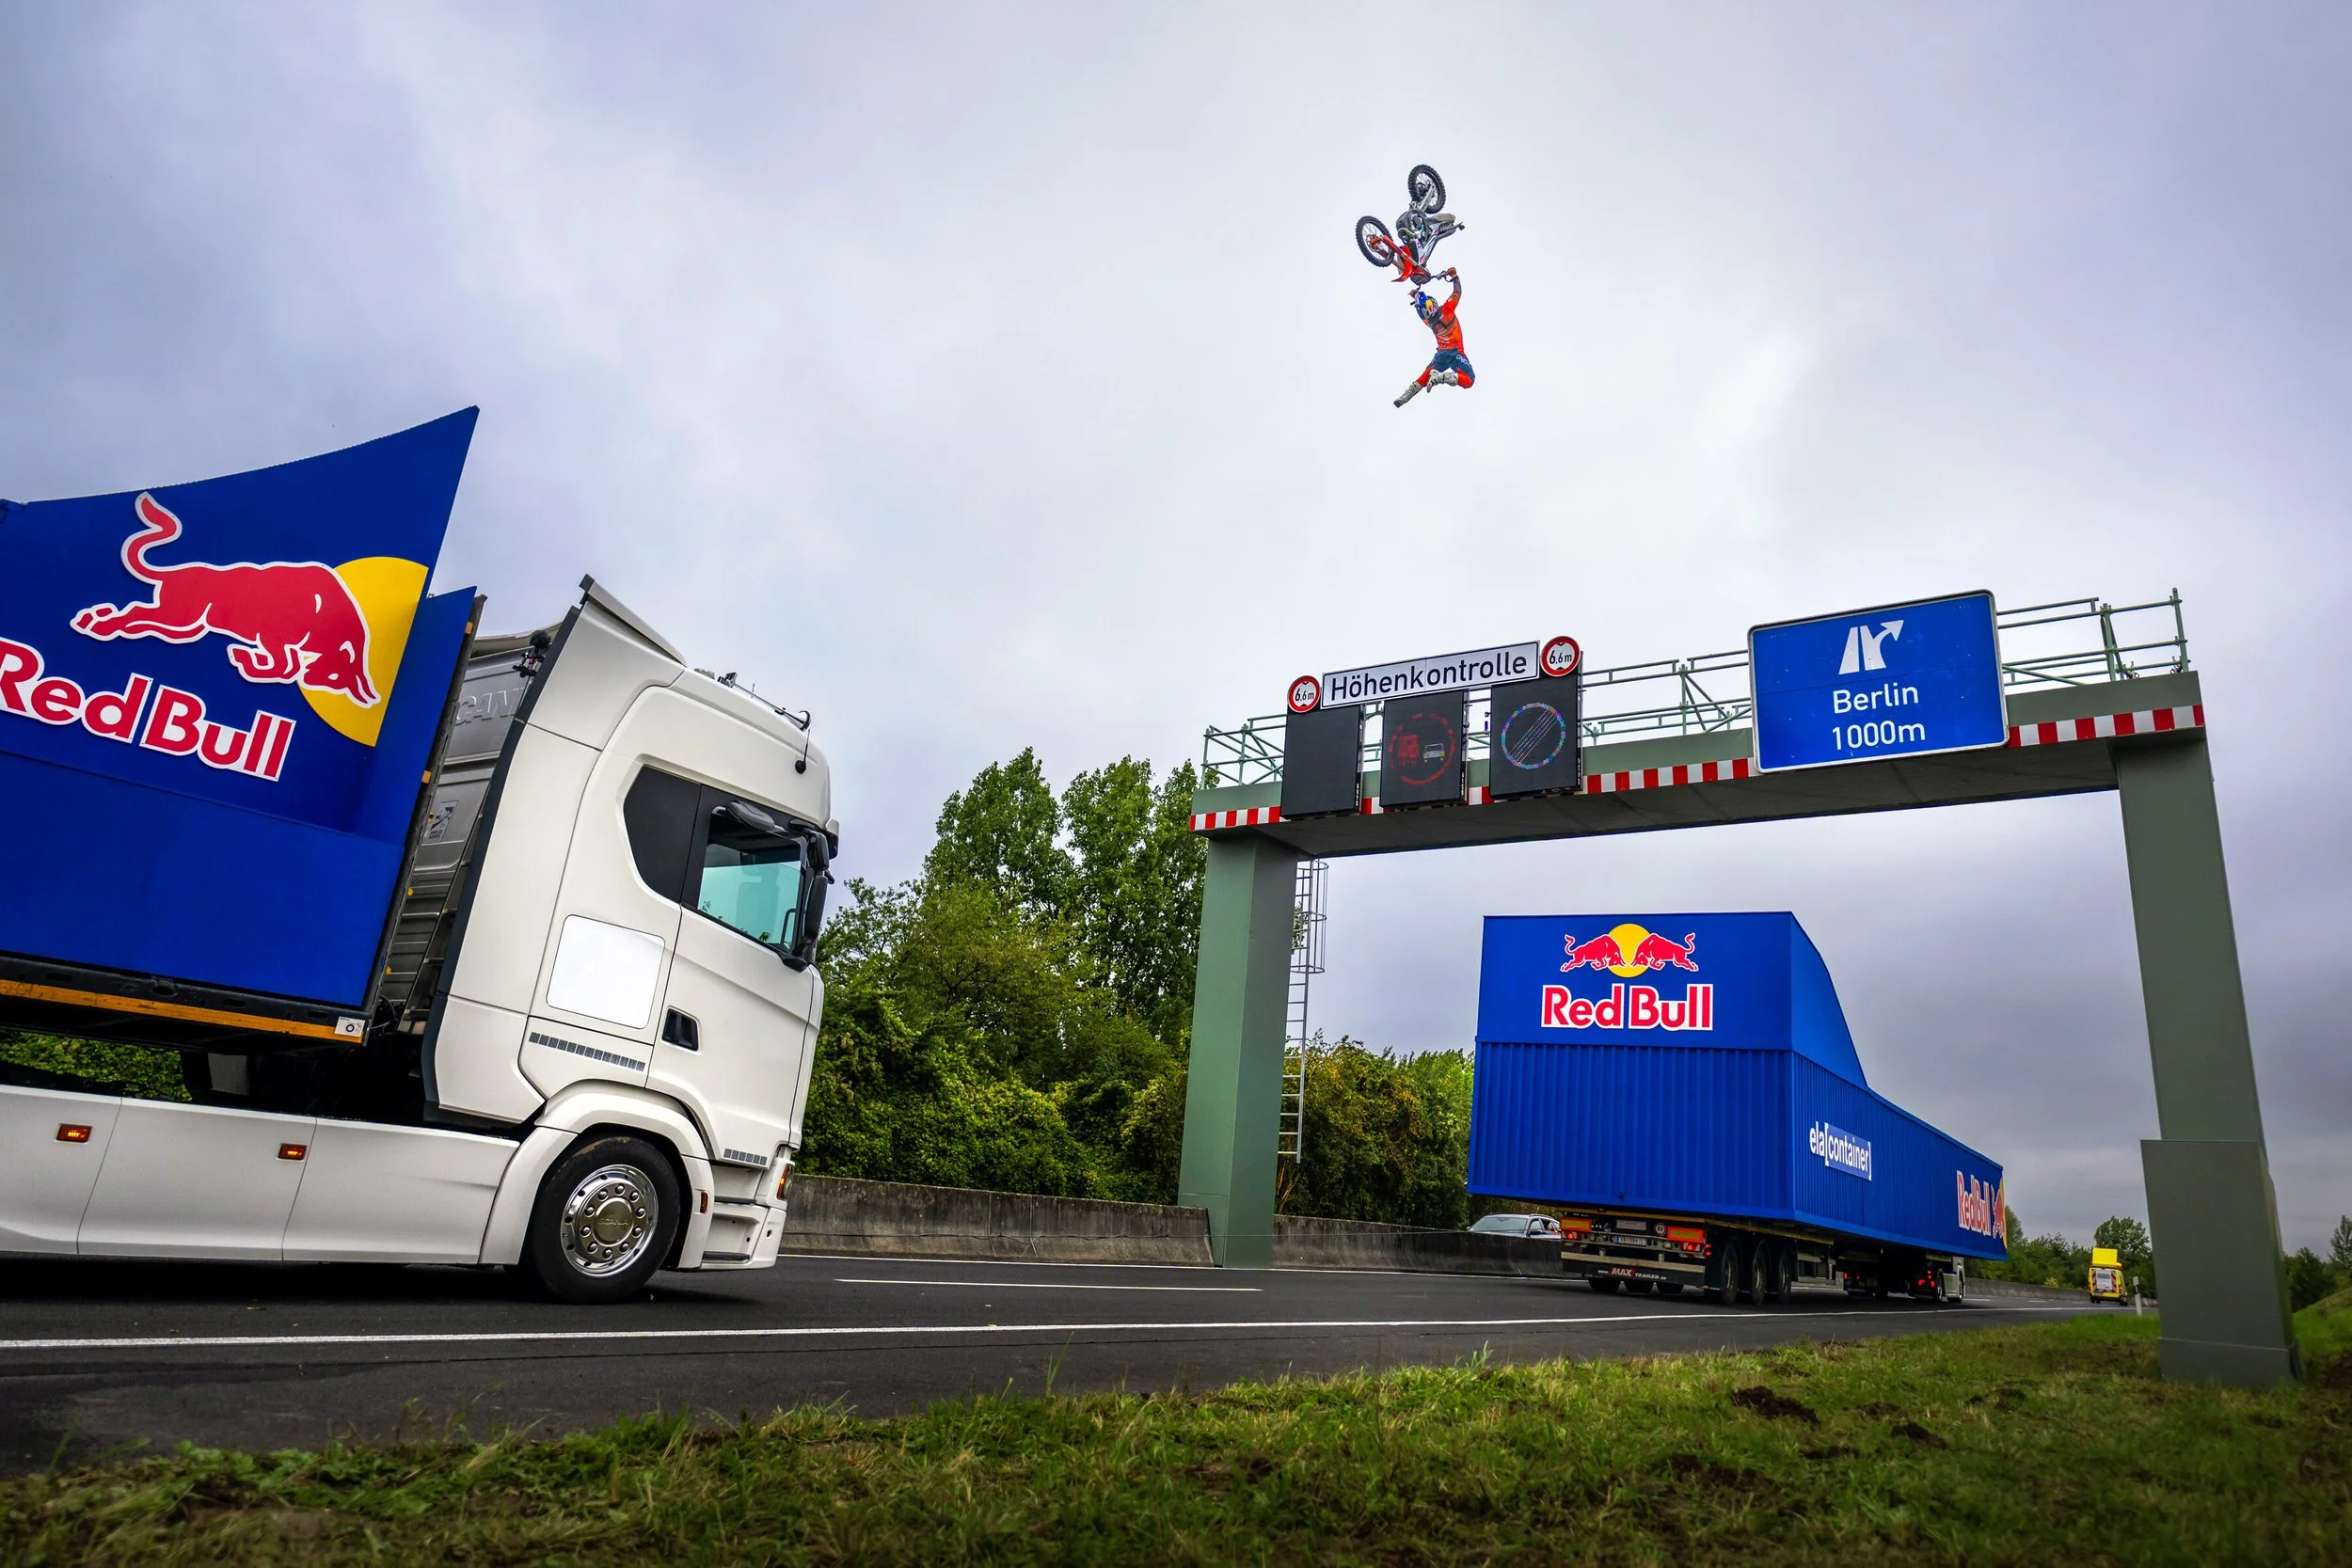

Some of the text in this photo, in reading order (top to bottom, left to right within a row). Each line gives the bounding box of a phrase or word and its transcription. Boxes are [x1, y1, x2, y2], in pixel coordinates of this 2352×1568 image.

[1331, 651, 1527, 701] Höhenkontrolle
[1833, 682, 1919, 714] Berlin
[0, 637, 296, 782] Red Bull
[1832, 720, 1926, 751] 1000m
[1541, 983, 1713, 1031] Red Bull
[1957, 1169, 1992, 1236] Red Bull
[1611, 1267, 1632, 1277] MAX
